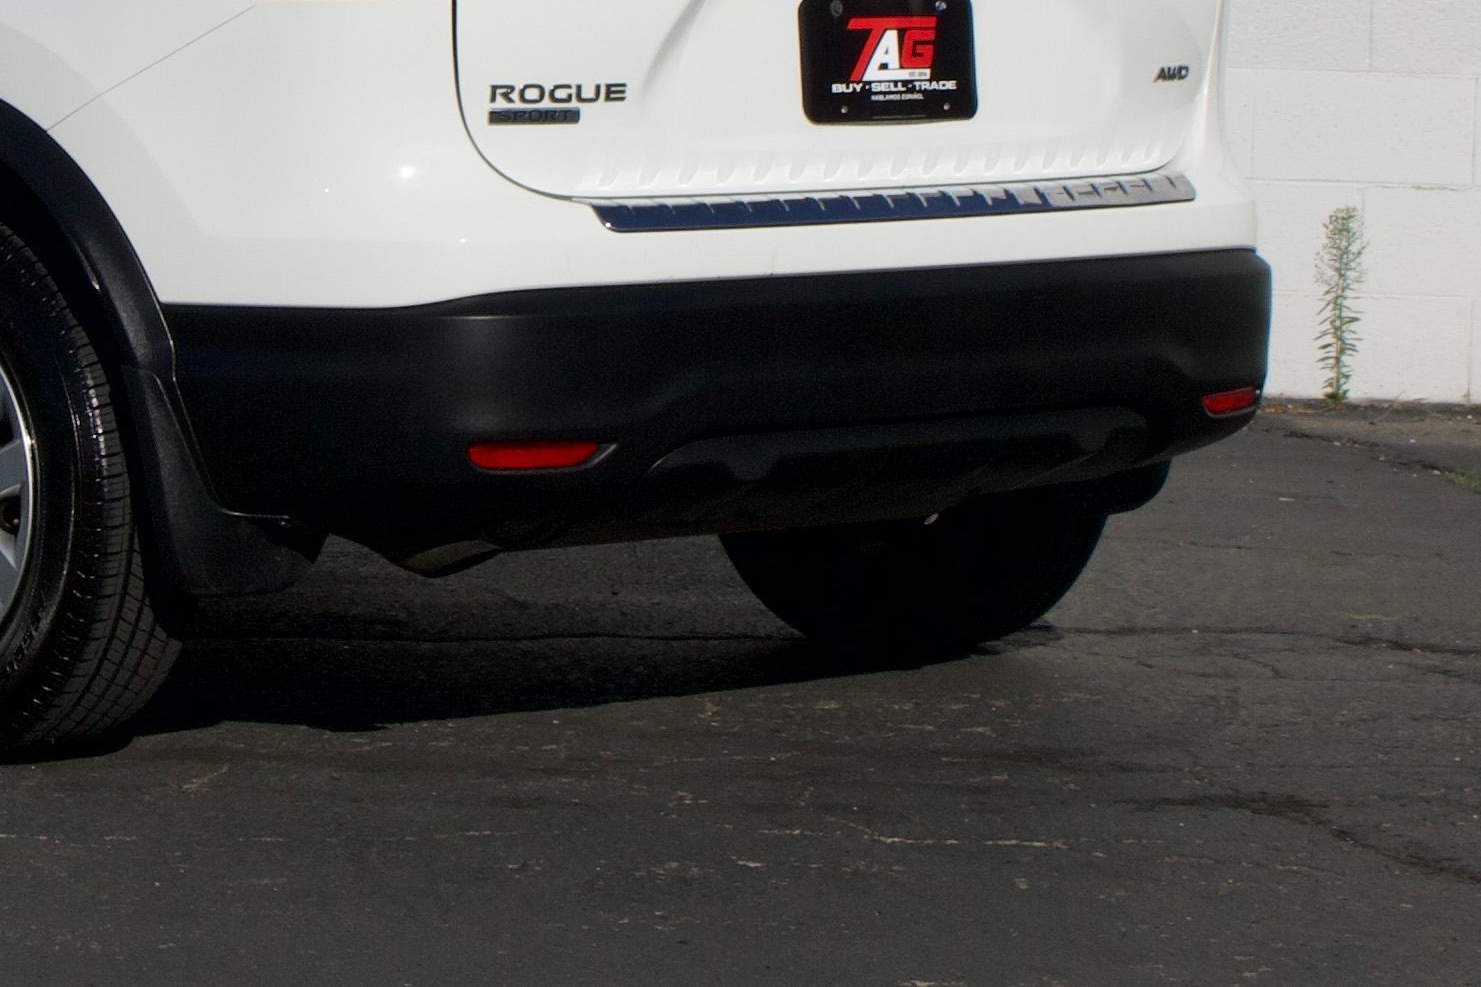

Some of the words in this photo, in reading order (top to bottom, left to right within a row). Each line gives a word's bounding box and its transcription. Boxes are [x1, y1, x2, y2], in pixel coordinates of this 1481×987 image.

[847, 16, 937, 81] TAG
[1153, 65, 1189, 82] AWD
[489, 83, 628, 104] ROGUE
[831, 83, 863, 93] BUY
[871, 82, 907, 92] SELL
[914, 80, 958, 90] TRADE
[498, 109, 570, 122] SPORT
